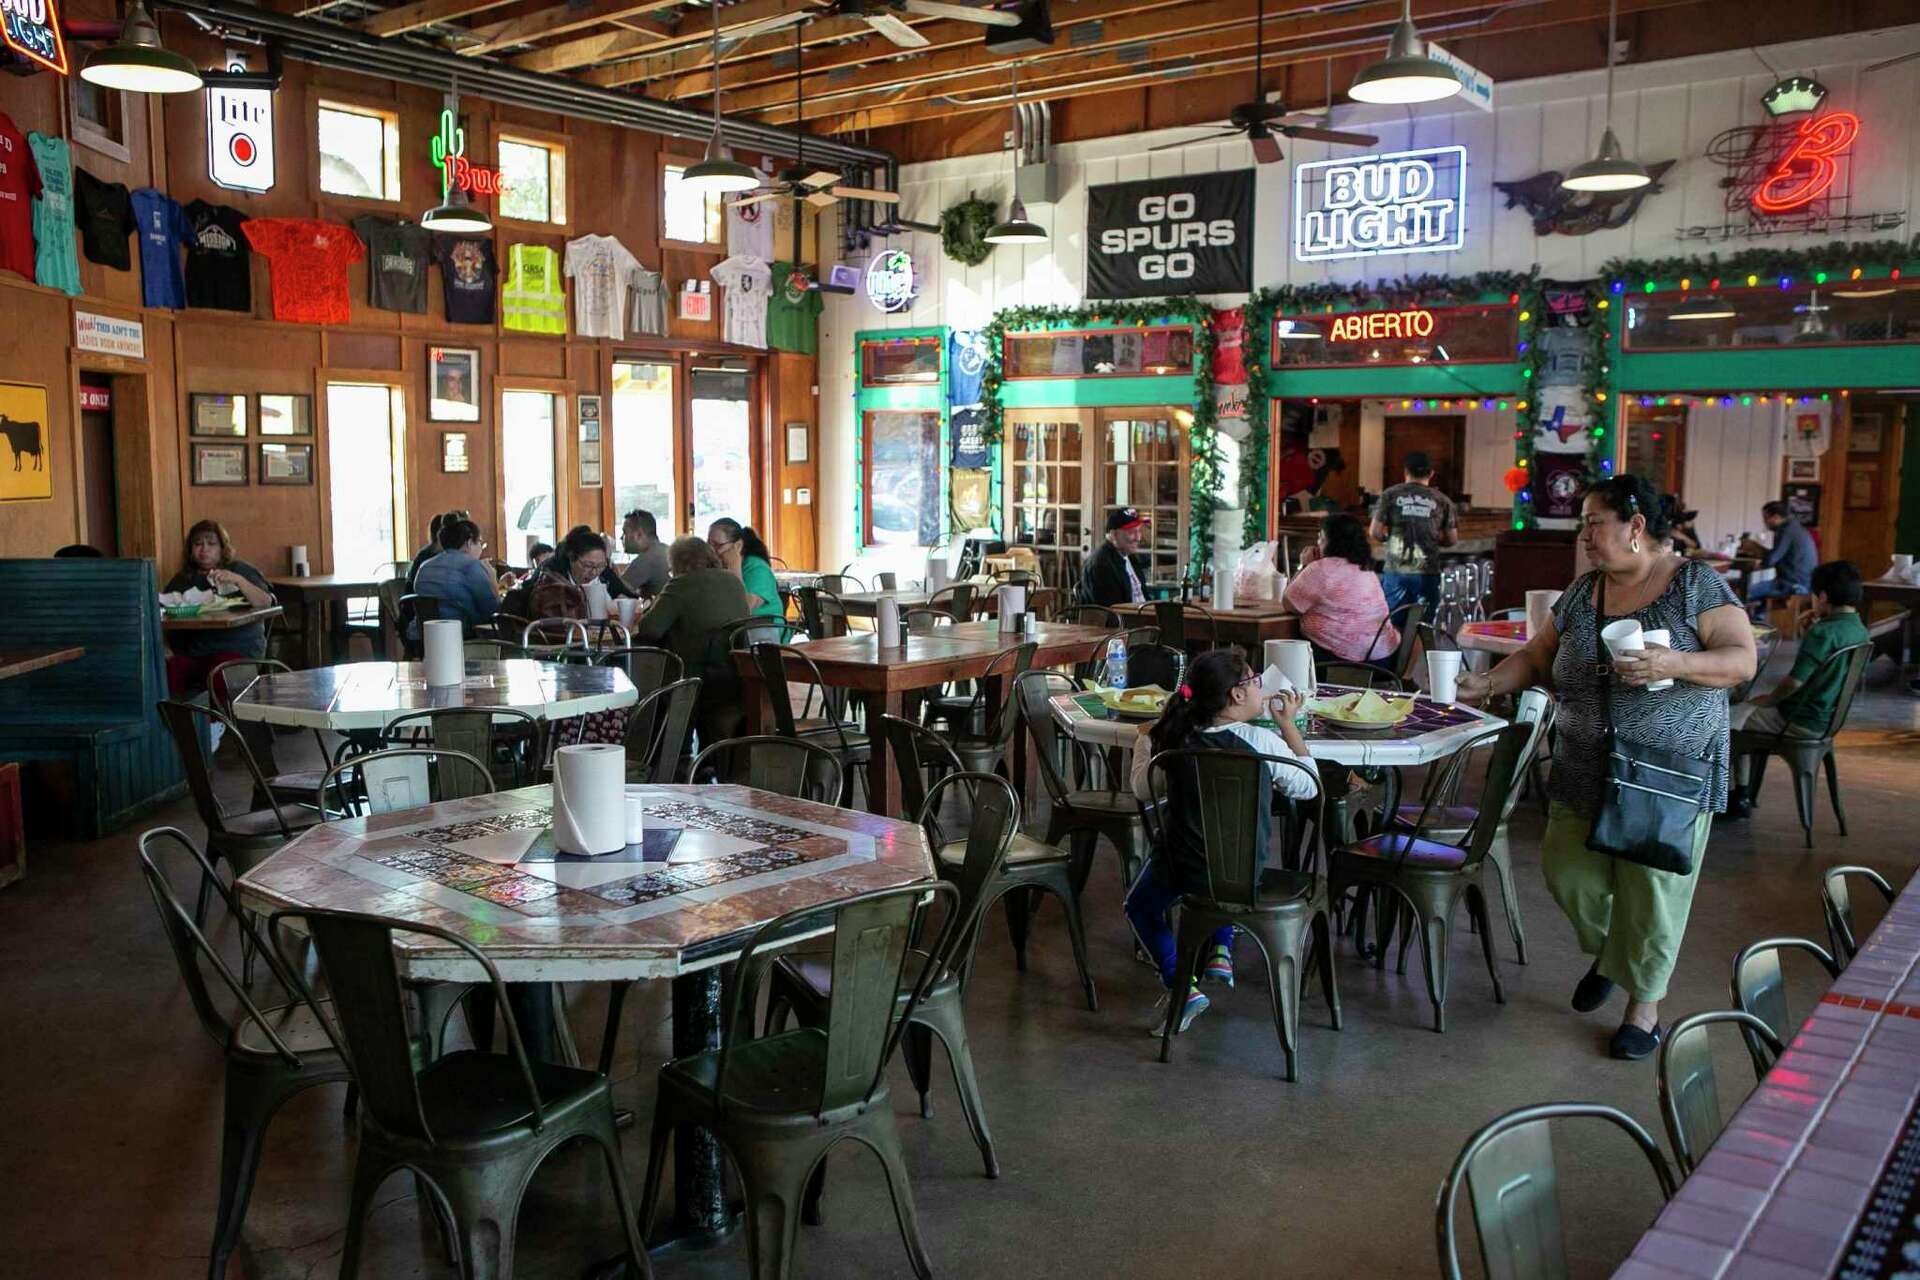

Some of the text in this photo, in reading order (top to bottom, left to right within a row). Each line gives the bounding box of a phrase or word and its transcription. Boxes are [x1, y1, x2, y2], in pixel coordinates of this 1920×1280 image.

[220, 94, 265, 126] Lite
[1324, 160, 1434, 209] BUD
[1138, 193, 1196, 222] GO
[1101, 219, 1235, 254] SPURS
[1304, 198, 1454, 252] LIGHT
[1138, 252, 1195, 281] GO
[1330, 311, 1434, 341] ABIERTO
[89, 393, 109, 406] ONLY
